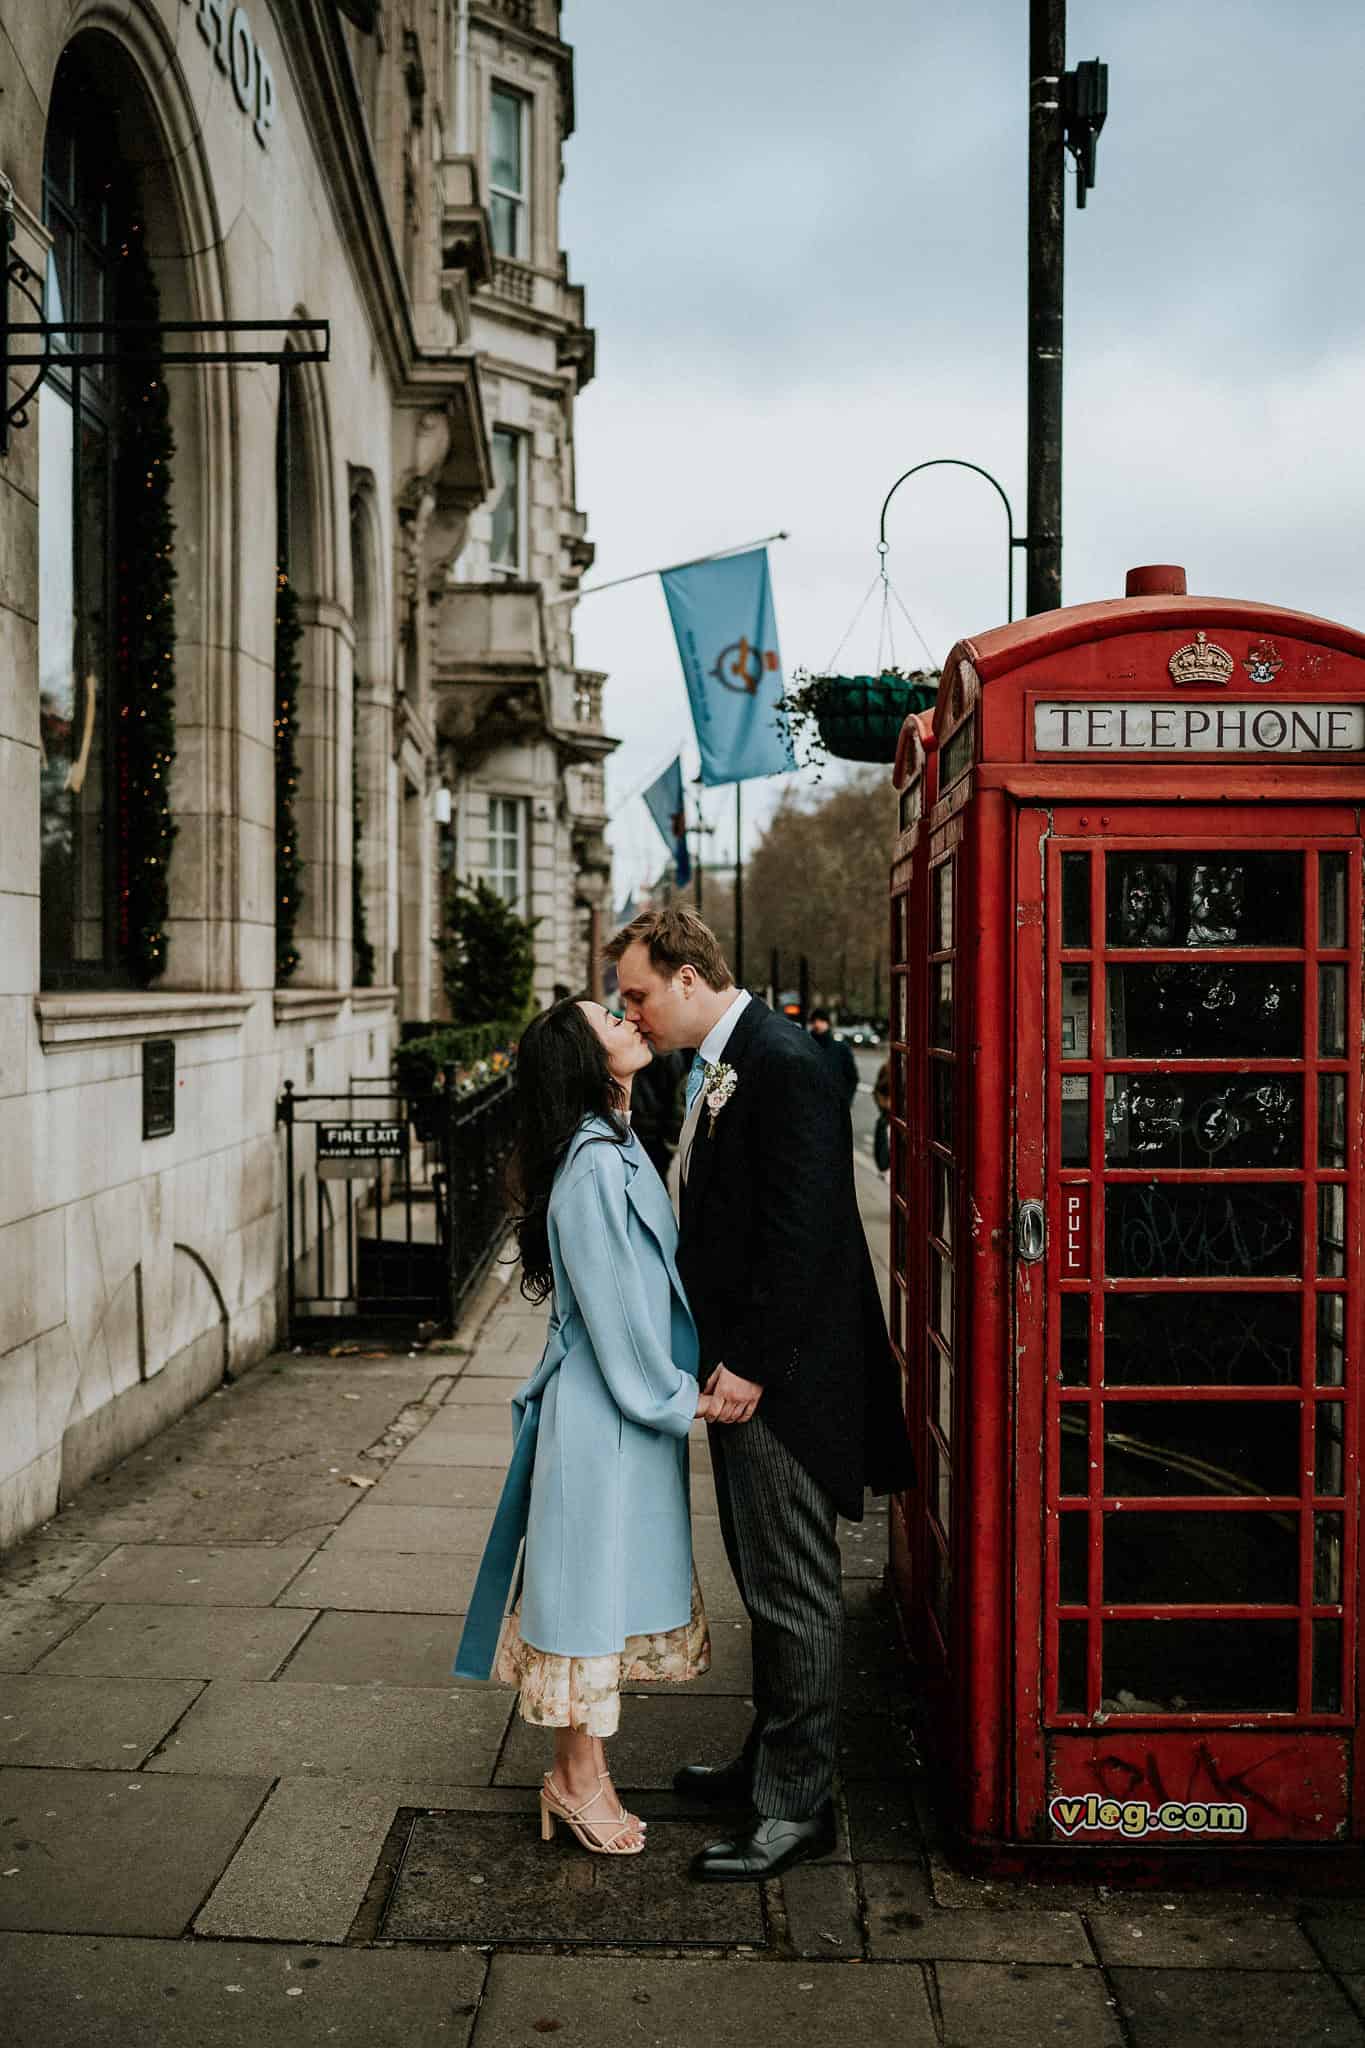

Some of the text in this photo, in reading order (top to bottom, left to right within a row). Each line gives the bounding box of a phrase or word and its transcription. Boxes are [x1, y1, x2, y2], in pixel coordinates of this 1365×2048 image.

[181, 0, 277, 151] HOP
[1050, 709, 1354, 749] TELEPHONE
[327, 1127, 400, 1144] FIRE EXIT
[1068, 1197, 1080, 1267] PULL
